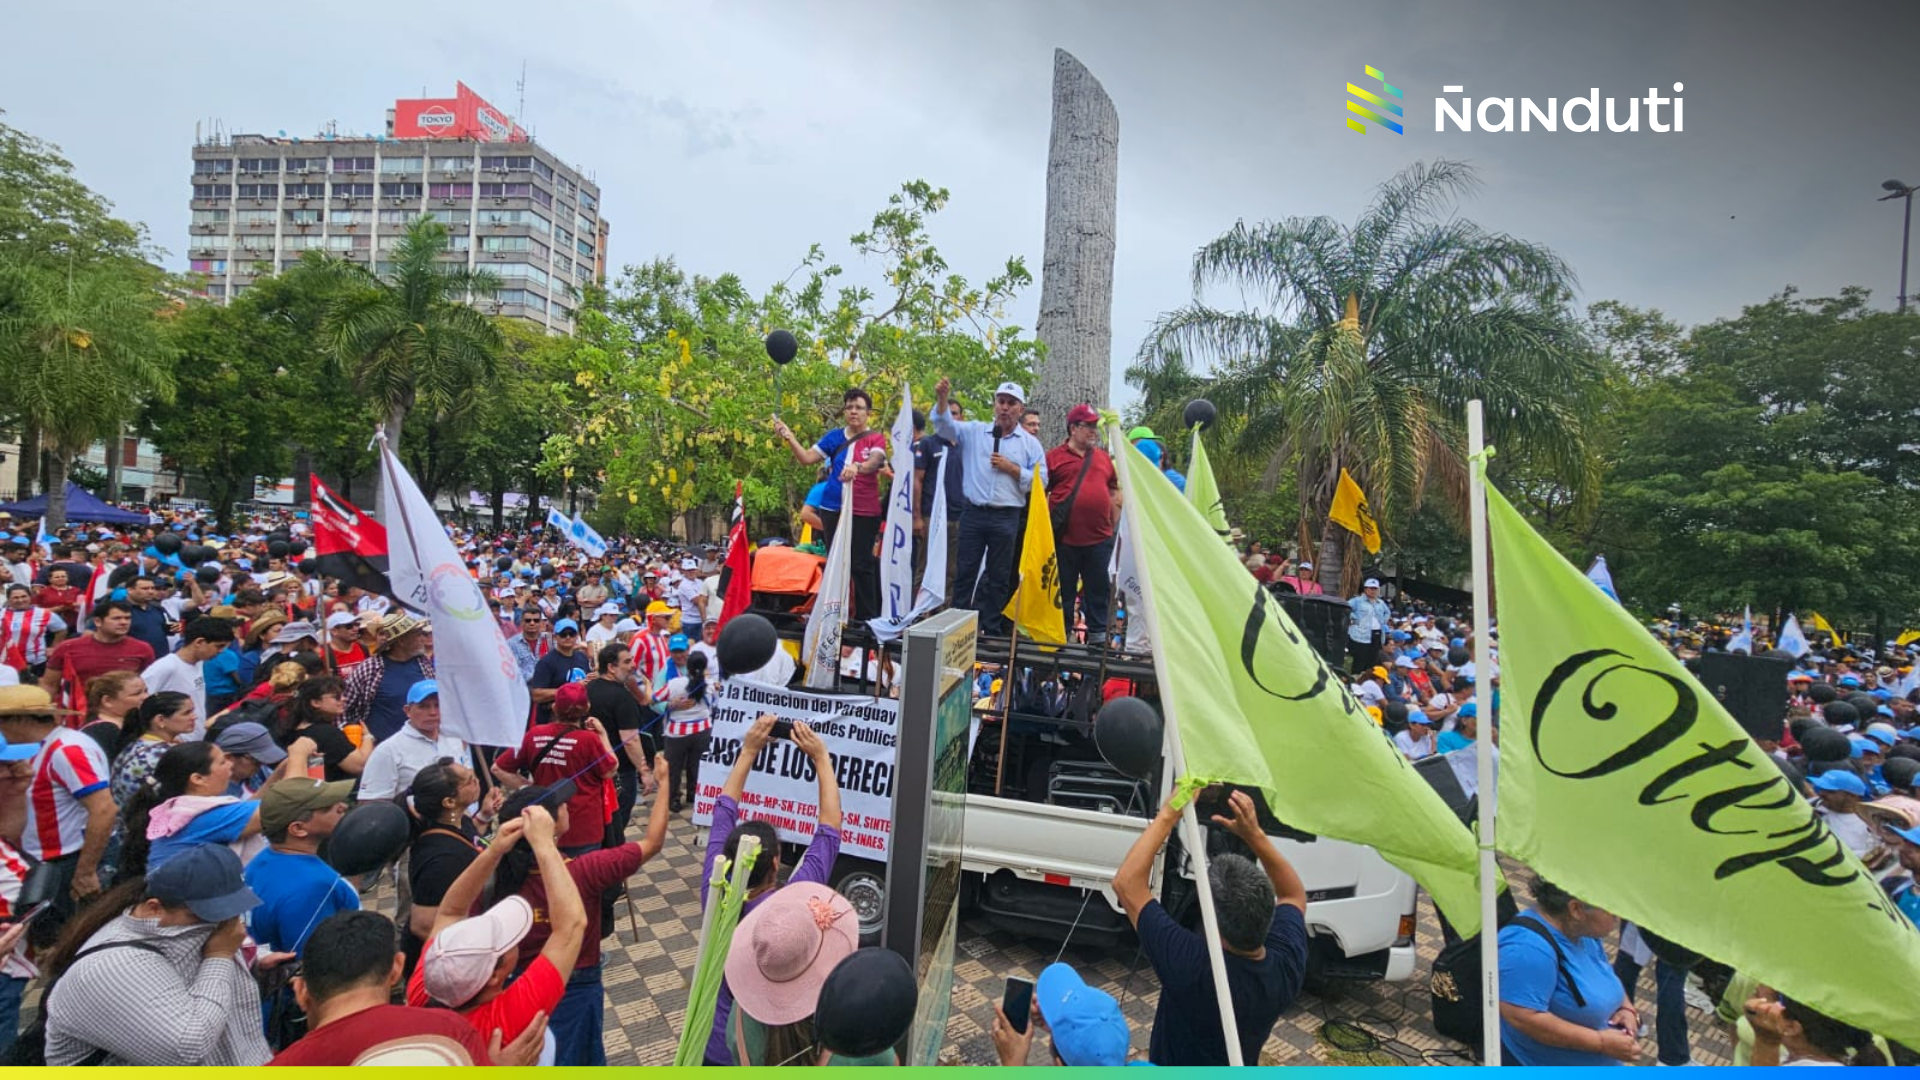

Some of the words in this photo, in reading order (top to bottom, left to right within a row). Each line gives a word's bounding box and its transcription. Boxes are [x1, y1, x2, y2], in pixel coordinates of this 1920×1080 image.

[421, 115, 452, 123] TOKYO
[727, 684, 740, 700] la
[743, 686, 808, 711] Educacion
[811, 698, 832, 715] del
[834, 701, 897, 726] Paraguay
[781, 744, 817, 782] LOS
